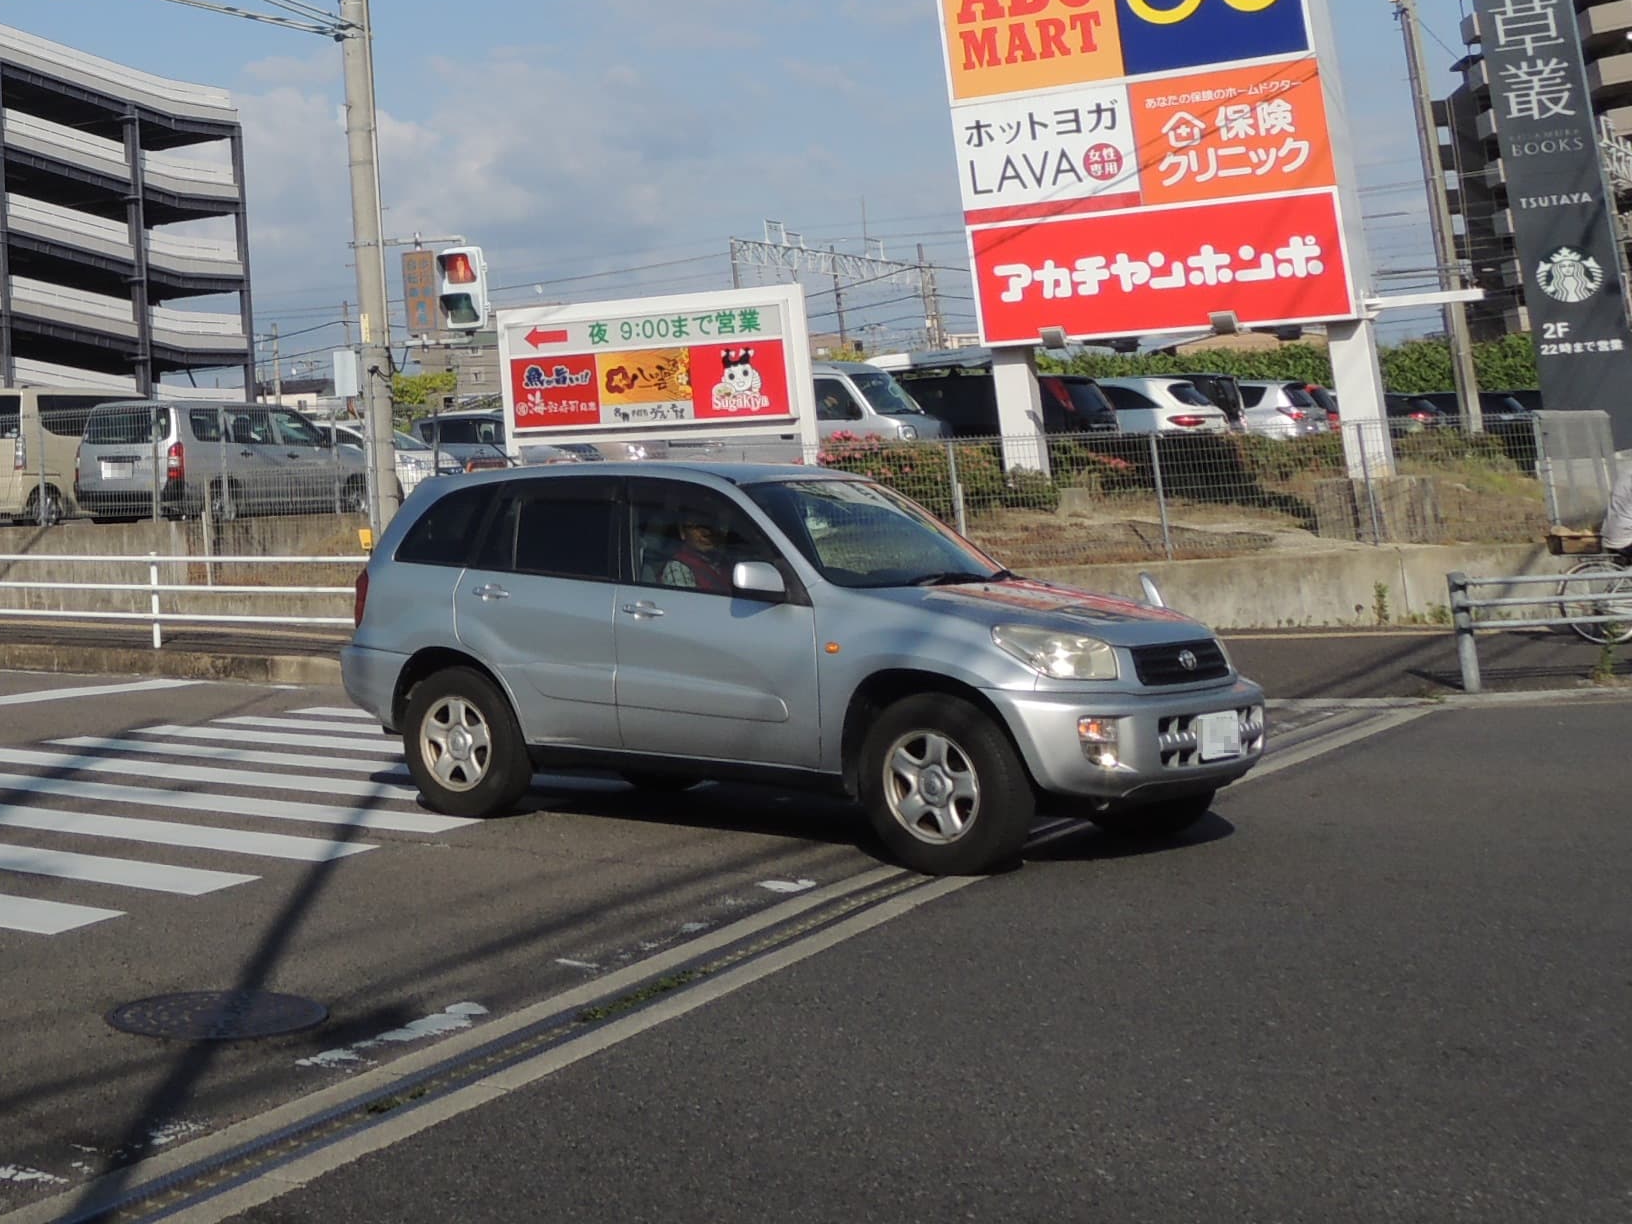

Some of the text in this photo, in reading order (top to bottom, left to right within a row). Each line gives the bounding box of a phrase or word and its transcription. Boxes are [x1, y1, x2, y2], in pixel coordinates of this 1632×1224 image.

[958, 10, 1101, 71] MART
[965, 99, 1118, 149] ホットヨガ
[1215, 98, 1296, 141] 保険
[1087, 146, 1118, 163] 女性
[1158, 137, 1311, 187] クリニック
[1511, 136, 1584, 157] BOOKS
[969, 147, 1083, 196] LAVA
[1090, 160, 1119, 176] 専用
[1519, 191, 1593, 209] TSUTAYA
[994, 235, 1324, 303] アカチャンホンポ
[588, 309, 761, 345] 夜 9:00まで営業
[1542, 321, 1570, 339] 2F
[1540, 339, 1624, 355] 22時まで営業
